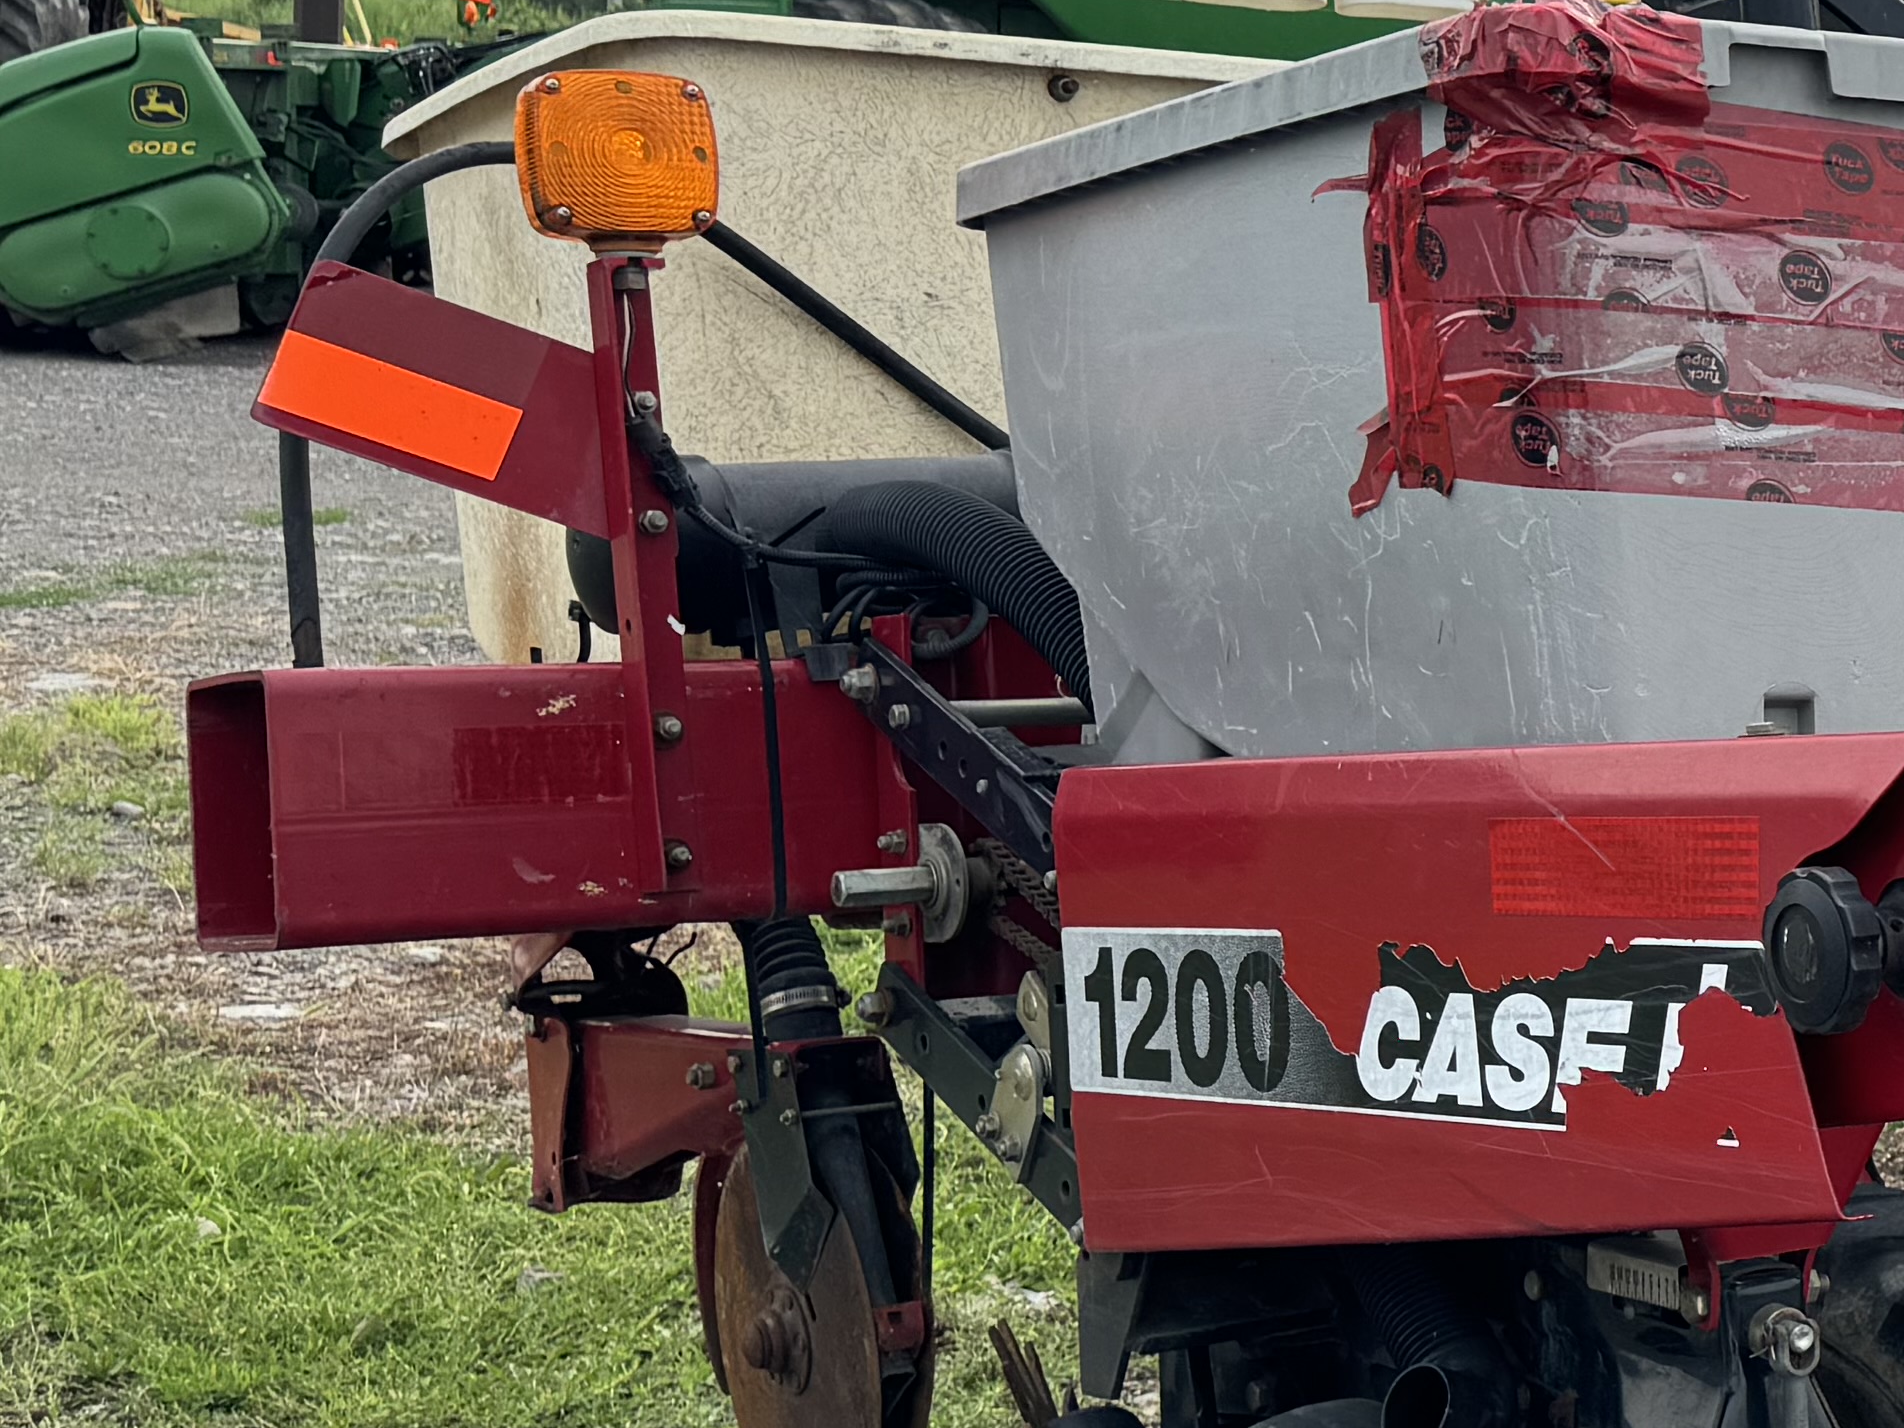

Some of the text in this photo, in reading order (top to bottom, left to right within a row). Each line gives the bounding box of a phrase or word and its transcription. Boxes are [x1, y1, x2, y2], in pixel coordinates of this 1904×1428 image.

[1786, 263, 1820, 279] Tape
[1789, 278, 1824, 293] Tuck
[1683, 354, 1717, 370] Tape
[1688, 369, 1721, 384] Tuck
[1083, 946, 1290, 1094] 1200
